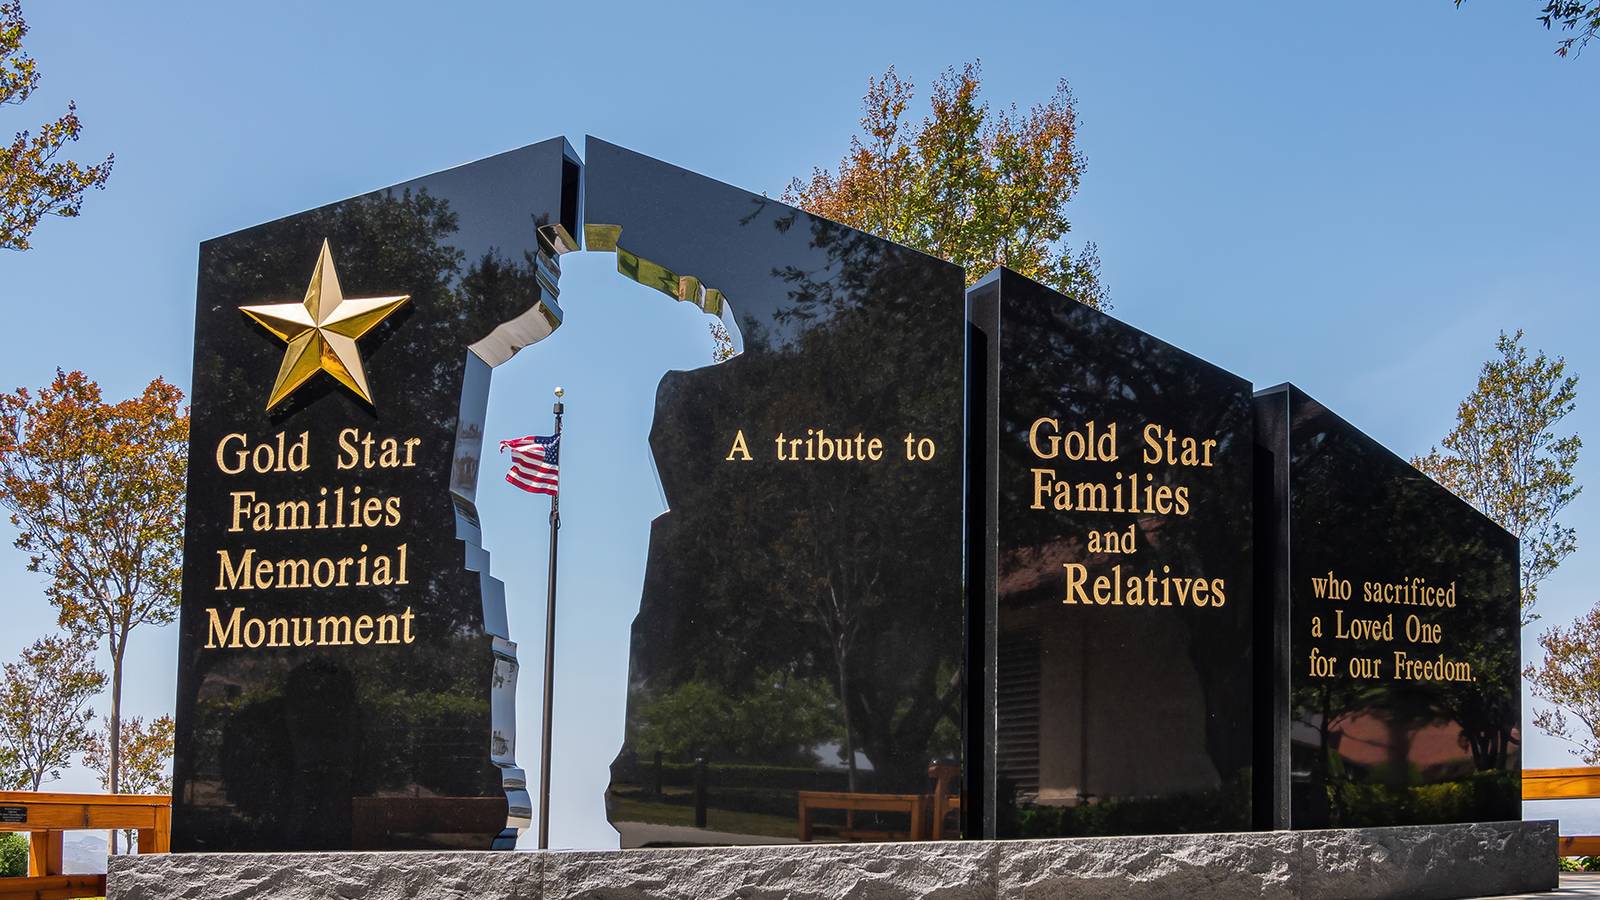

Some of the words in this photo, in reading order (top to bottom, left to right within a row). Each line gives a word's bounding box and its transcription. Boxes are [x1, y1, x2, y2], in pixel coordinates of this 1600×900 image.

[216, 431, 311, 475] Gold
[336, 428, 422, 470] Star
[725, 429, 753, 461] A
[775, 429, 883, 461] tribute
[903, 432, 936, 461] to
[1030, 417, 1119, 461] Gold
[1143, 423, 1217, 467] Star
[228, 486, 402, 532] Families
[1030, 468, 1190, 515] Families
[1087, 523, 1137, 554] and
[215, 543, 410, 591] Memorial
[1062, 562, 1226, 608] Relatives
[1311, 570, 1352, 601] who
[1363, 576, 1456, 608] sacrificed
[205, 607, 416, 649] Monument
[1311, 616, 1323, 638] a
[1335, 609, 1394, 641] Loved
[1405, 614, 1442, 644] One
[1309, 647, 1337, 677] for
[1349, 657, 1382, 679] our
[1393, 651, 1477, 682] Freedom.
